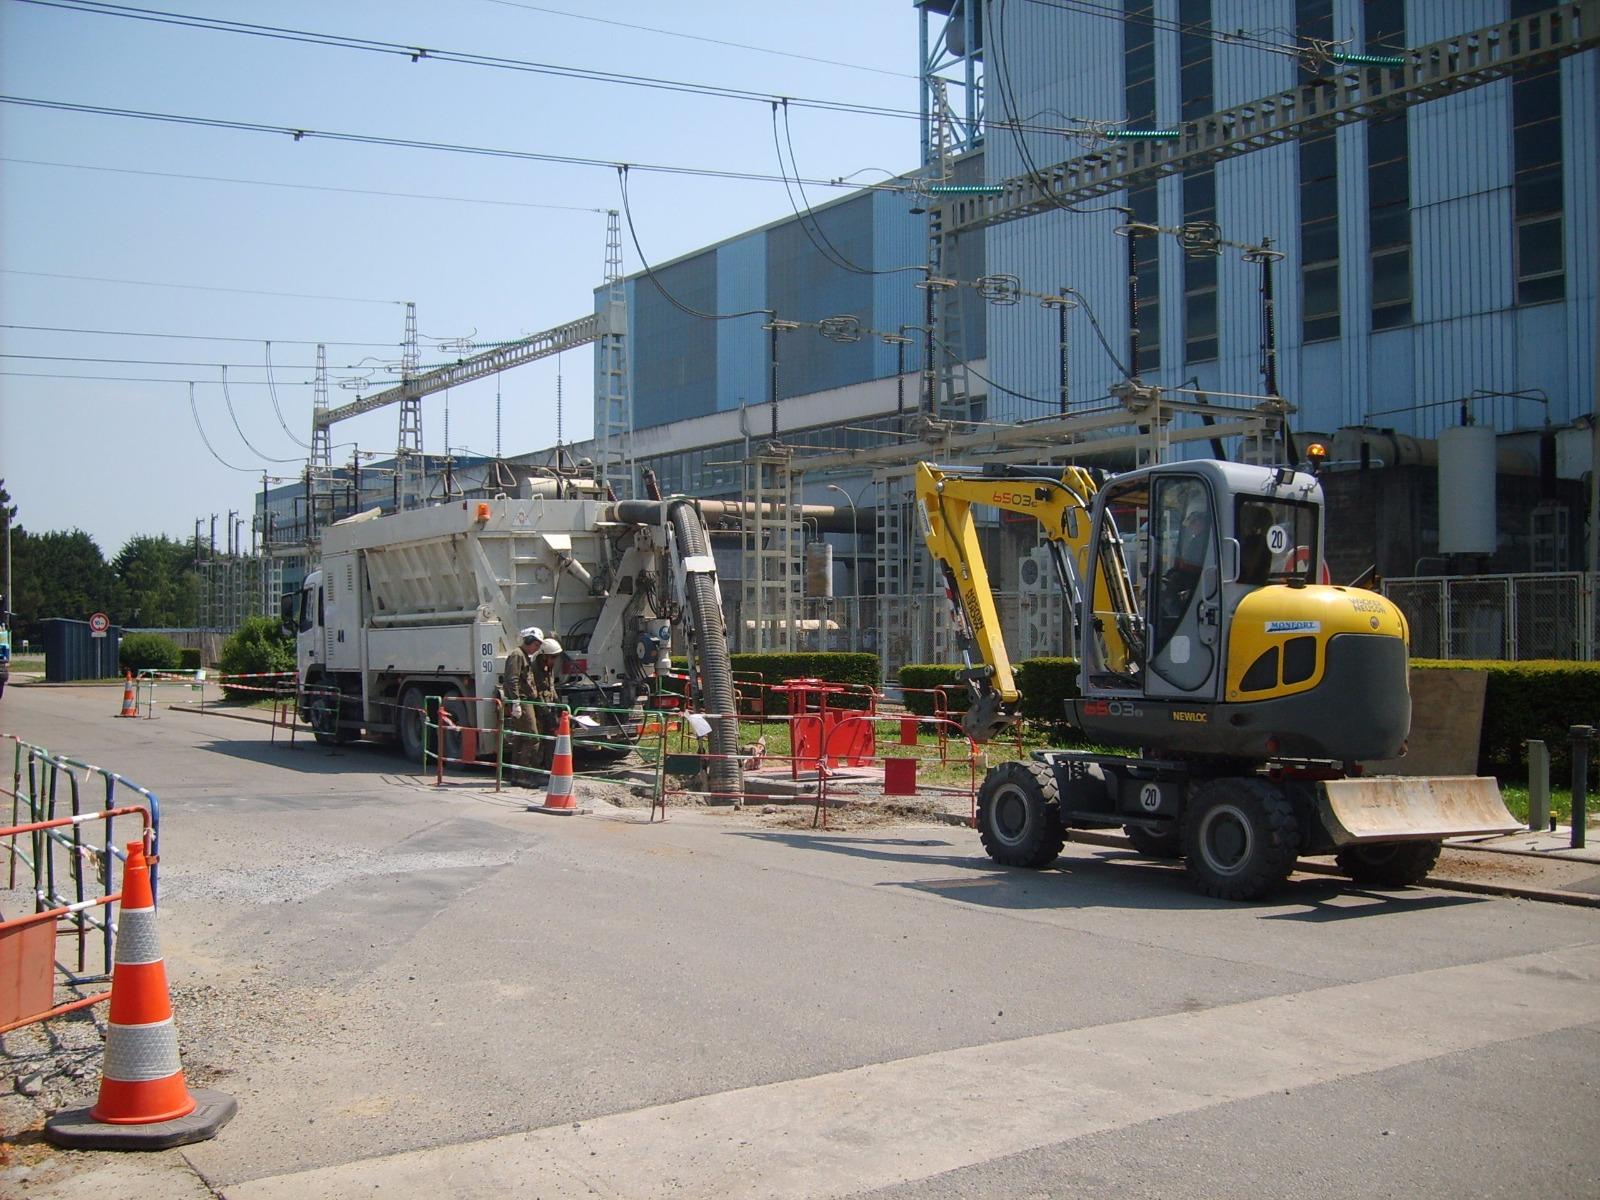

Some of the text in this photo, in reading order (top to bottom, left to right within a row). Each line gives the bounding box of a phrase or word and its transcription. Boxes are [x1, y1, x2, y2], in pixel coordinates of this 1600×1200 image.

[1271, 530, 1283, 549] 20
[481, 643, 493, 656] 80
[482, 660, 493, 673] 90
[1172, 711, 1208, 723] NEWLOC
[1145, 788, 1157, 807] 20
